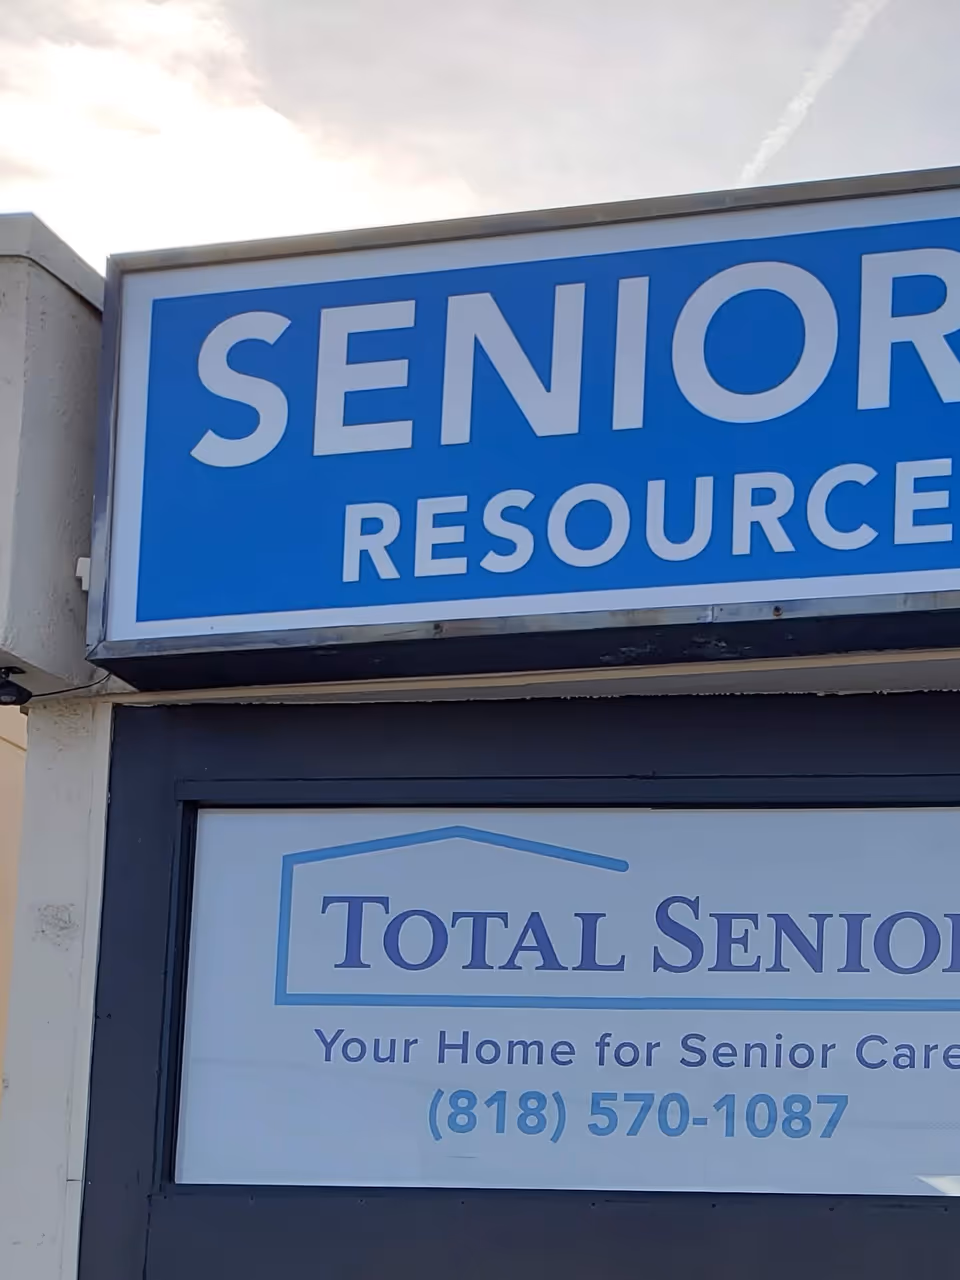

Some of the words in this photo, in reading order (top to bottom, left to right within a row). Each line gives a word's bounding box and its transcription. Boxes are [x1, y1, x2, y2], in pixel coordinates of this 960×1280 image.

[342, 457, 953, 582] RESOURCE
[320, 895, 626, 972] TOTAL
[314, 1028, 419, 1064] Your
[437, 1030, 576, 1067] Home
[594, 1032, 661, 1068] for
[679, 1033, 837, 1069] Senior
[428, 1087, 567, 1144] (818)
[587, 1091, 849, 1139] 570-1087
